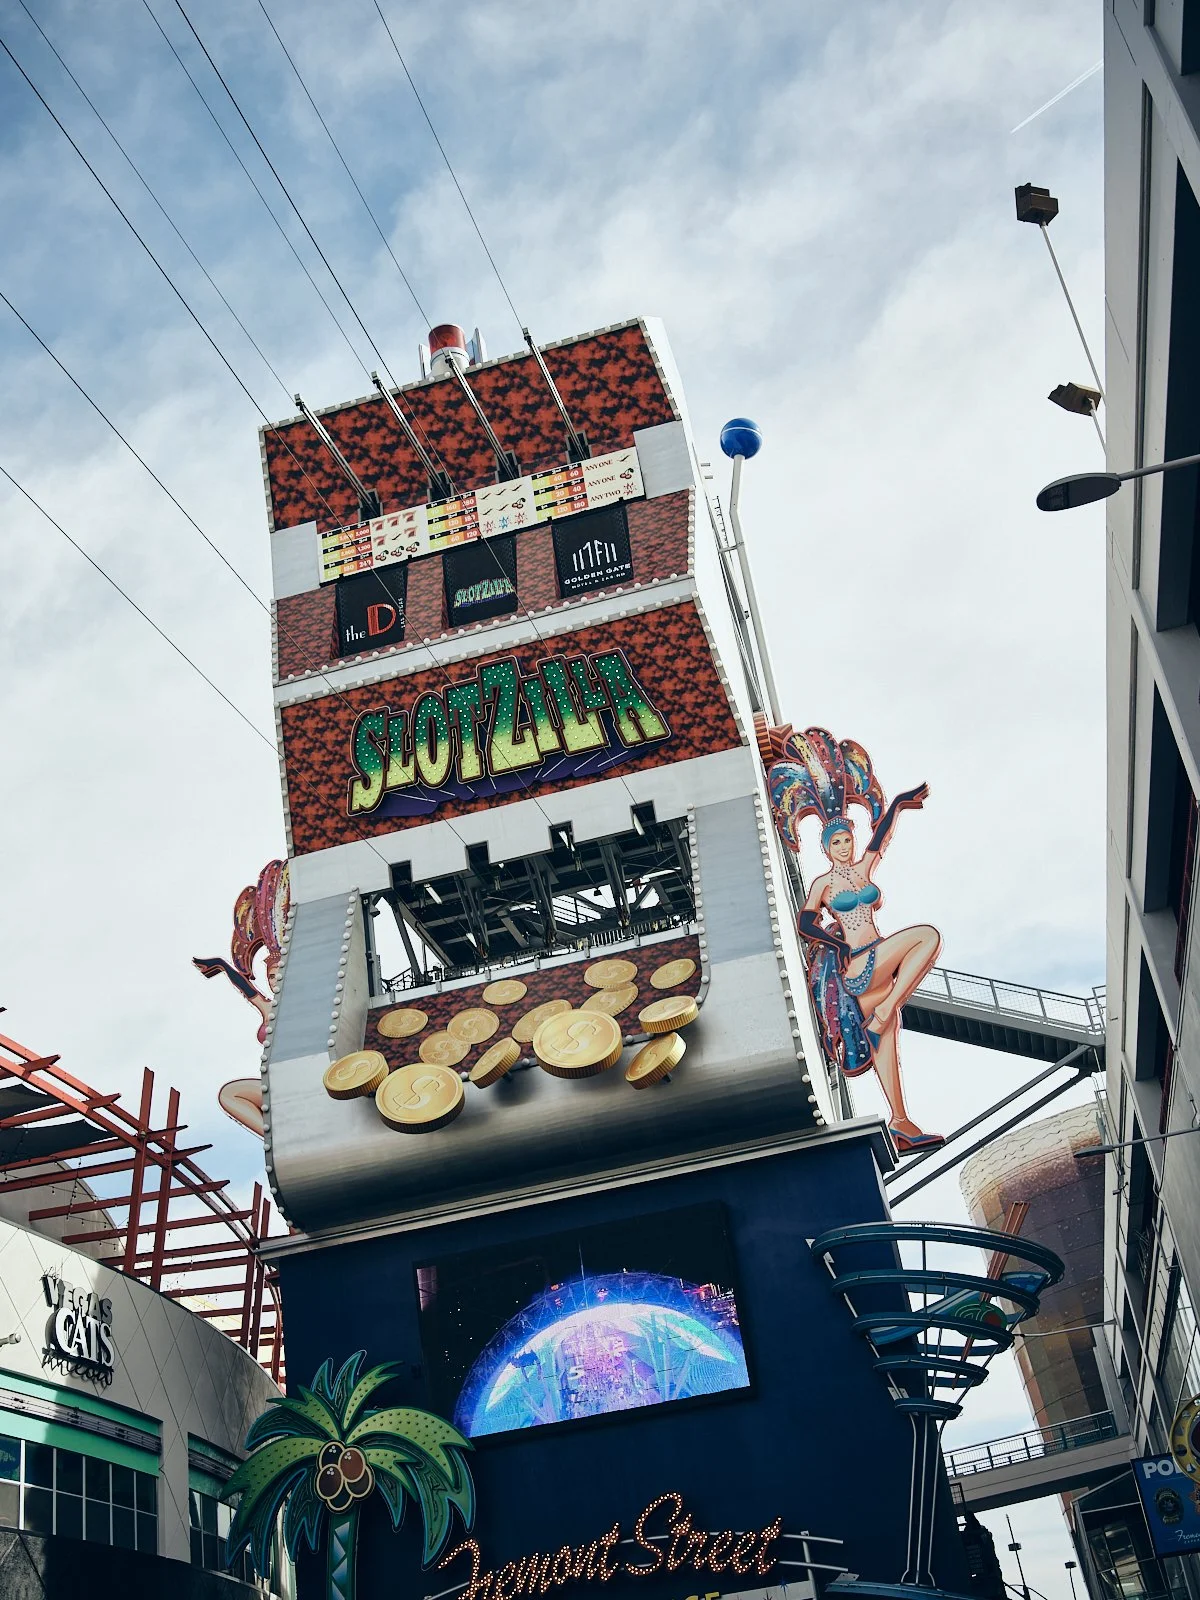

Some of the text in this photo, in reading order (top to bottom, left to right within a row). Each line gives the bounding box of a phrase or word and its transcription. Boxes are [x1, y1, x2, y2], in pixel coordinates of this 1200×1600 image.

[585, 459, 613, 471] ANY ONE
[588, 475, 616, 487] ANY ONE
[591, 489, 621, 502] ANY TWO
[466, 530, 478, 538] 120
[564, 563, 631, 585] GOLDEN GATE
[346, 603, 397, 642] the D
[347, 648, 671, 816] SLOTZILLA
[41, 1275, 113, 1323] VEGAS
[55, 1307, 115, 1367] CATS
[1142, 1459, 1184, 1479] PO
[437, 1490, 784, 1600] Fremont Street
